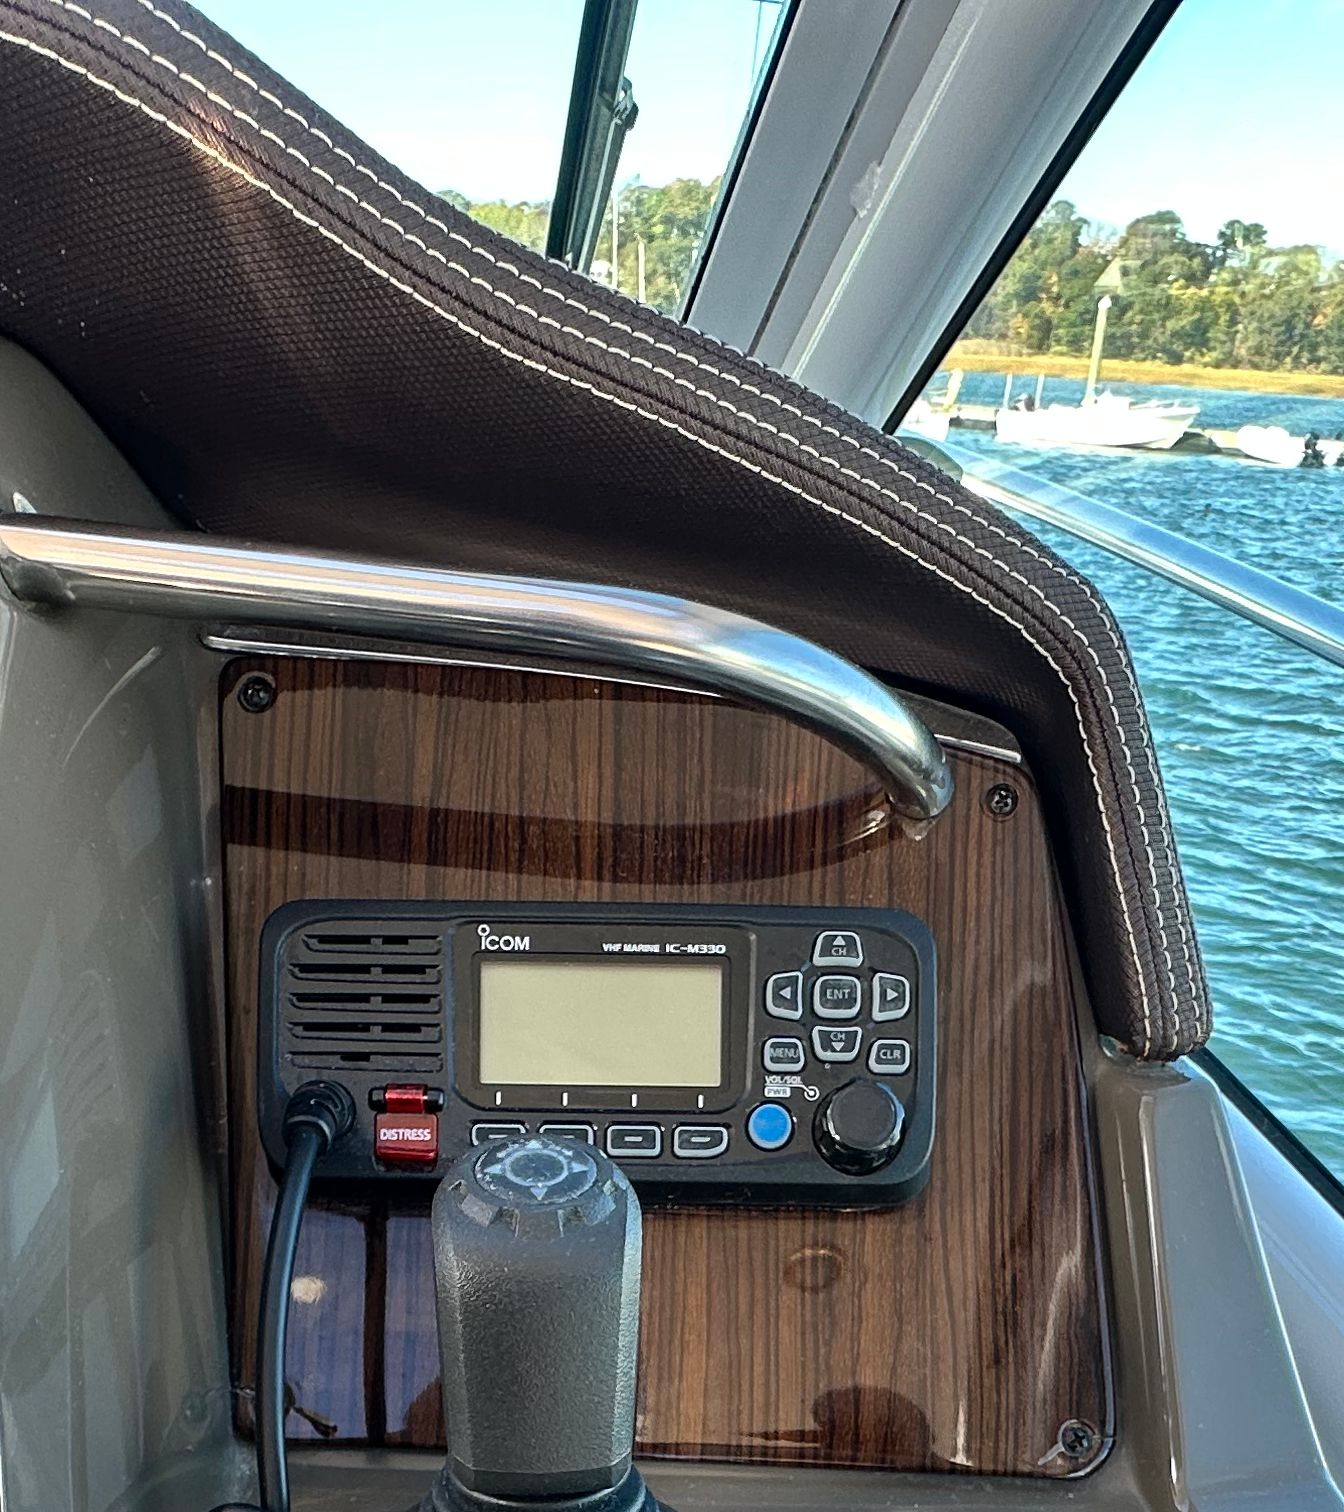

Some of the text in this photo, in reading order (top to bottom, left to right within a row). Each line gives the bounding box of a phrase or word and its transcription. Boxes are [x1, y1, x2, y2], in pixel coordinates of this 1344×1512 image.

[665, 943, 727, 954] IC-M330
[831, 947, 847, 956] CH
[826, 989, 851, 999] ENT
[830, 1032, 845, 1041] CH
[770, 1048, 799, 1058] MENU
[879, 1052, 901, 1060] CLR
[379, 1128, 432, 1141] DISTRESS
